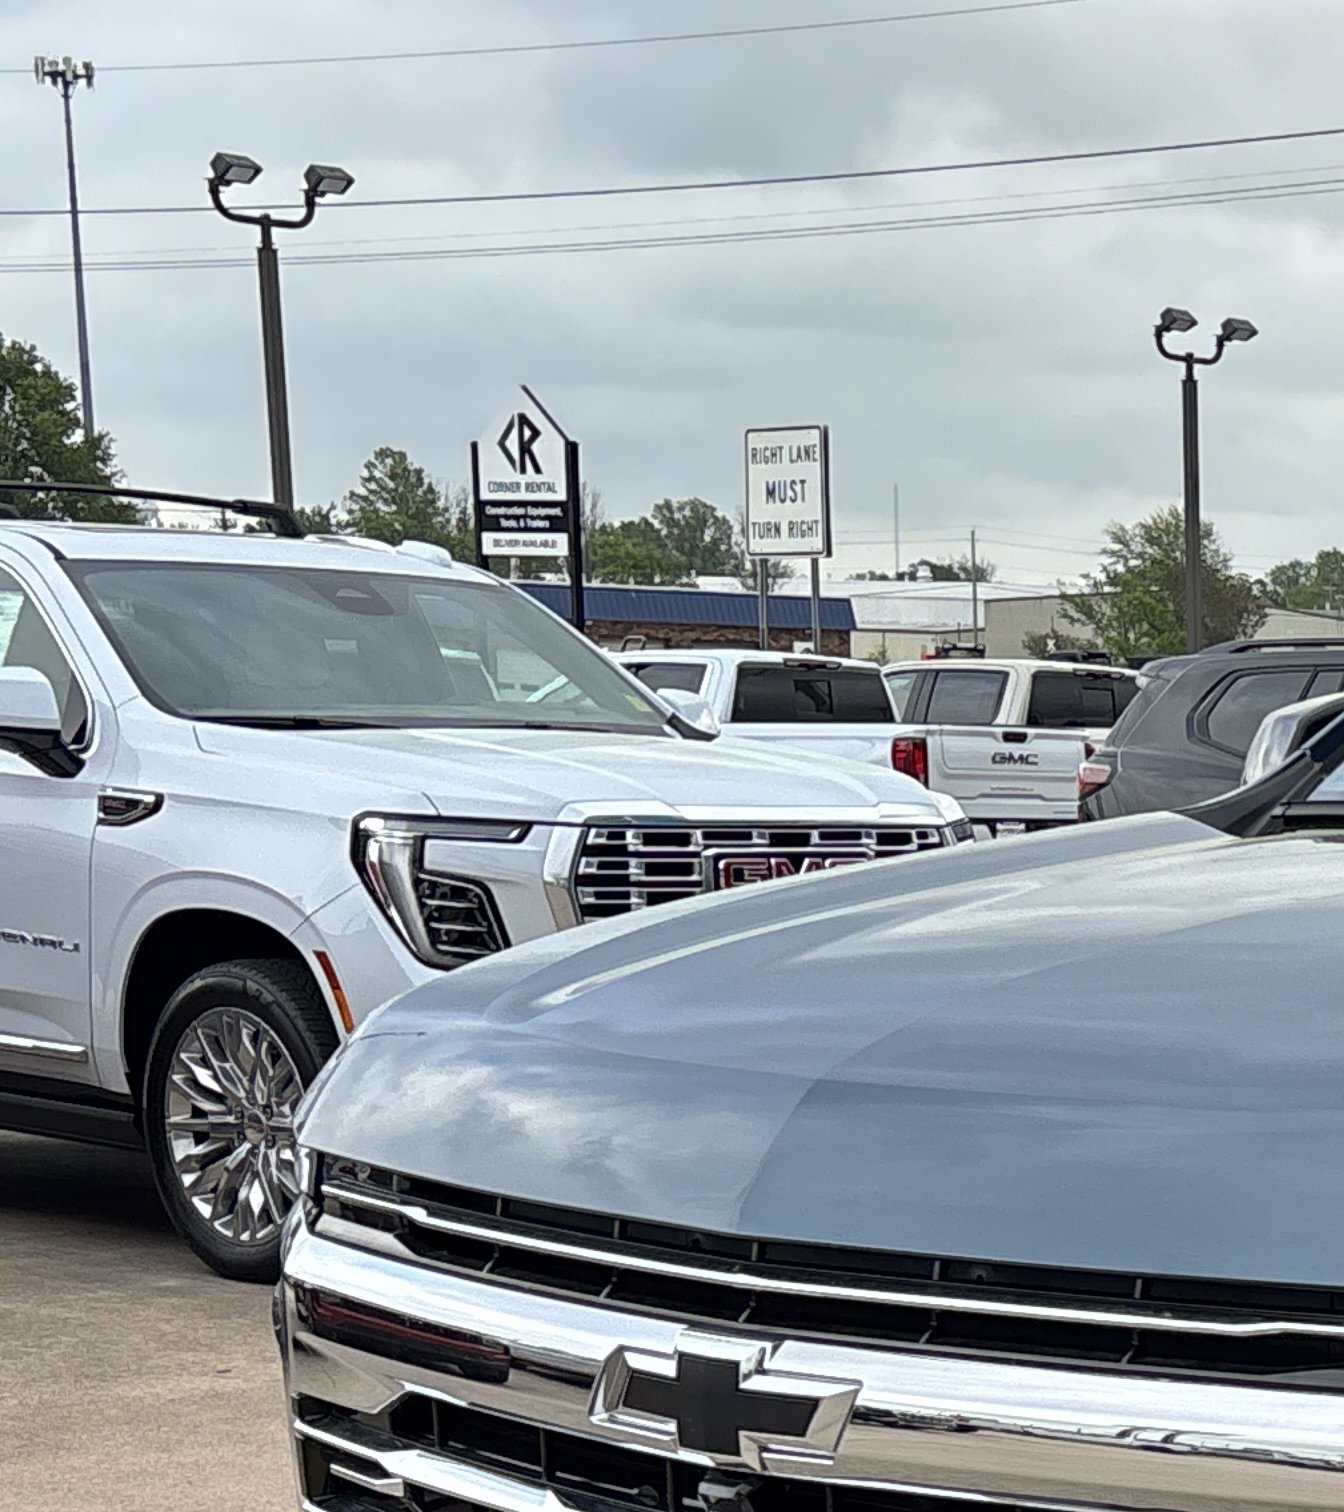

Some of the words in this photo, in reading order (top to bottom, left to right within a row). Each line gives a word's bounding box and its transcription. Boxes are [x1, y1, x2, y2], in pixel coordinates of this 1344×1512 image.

[751, 445, 784, 465] RIGHT
[788, 443, 818, 464] LANE
[487, 480, 521, 493] CORNER
[525, 480, 557, 494] RENTAL
[765, 479, 807, 504] MUST
[751, 521, 782, 539] TURN
[788, 519, 819, 539] RIGHT
[991, 752, 1039, 766] GMC
[718, 858, 868, 888] GM
[0, 928, 80, 952] ENALI
